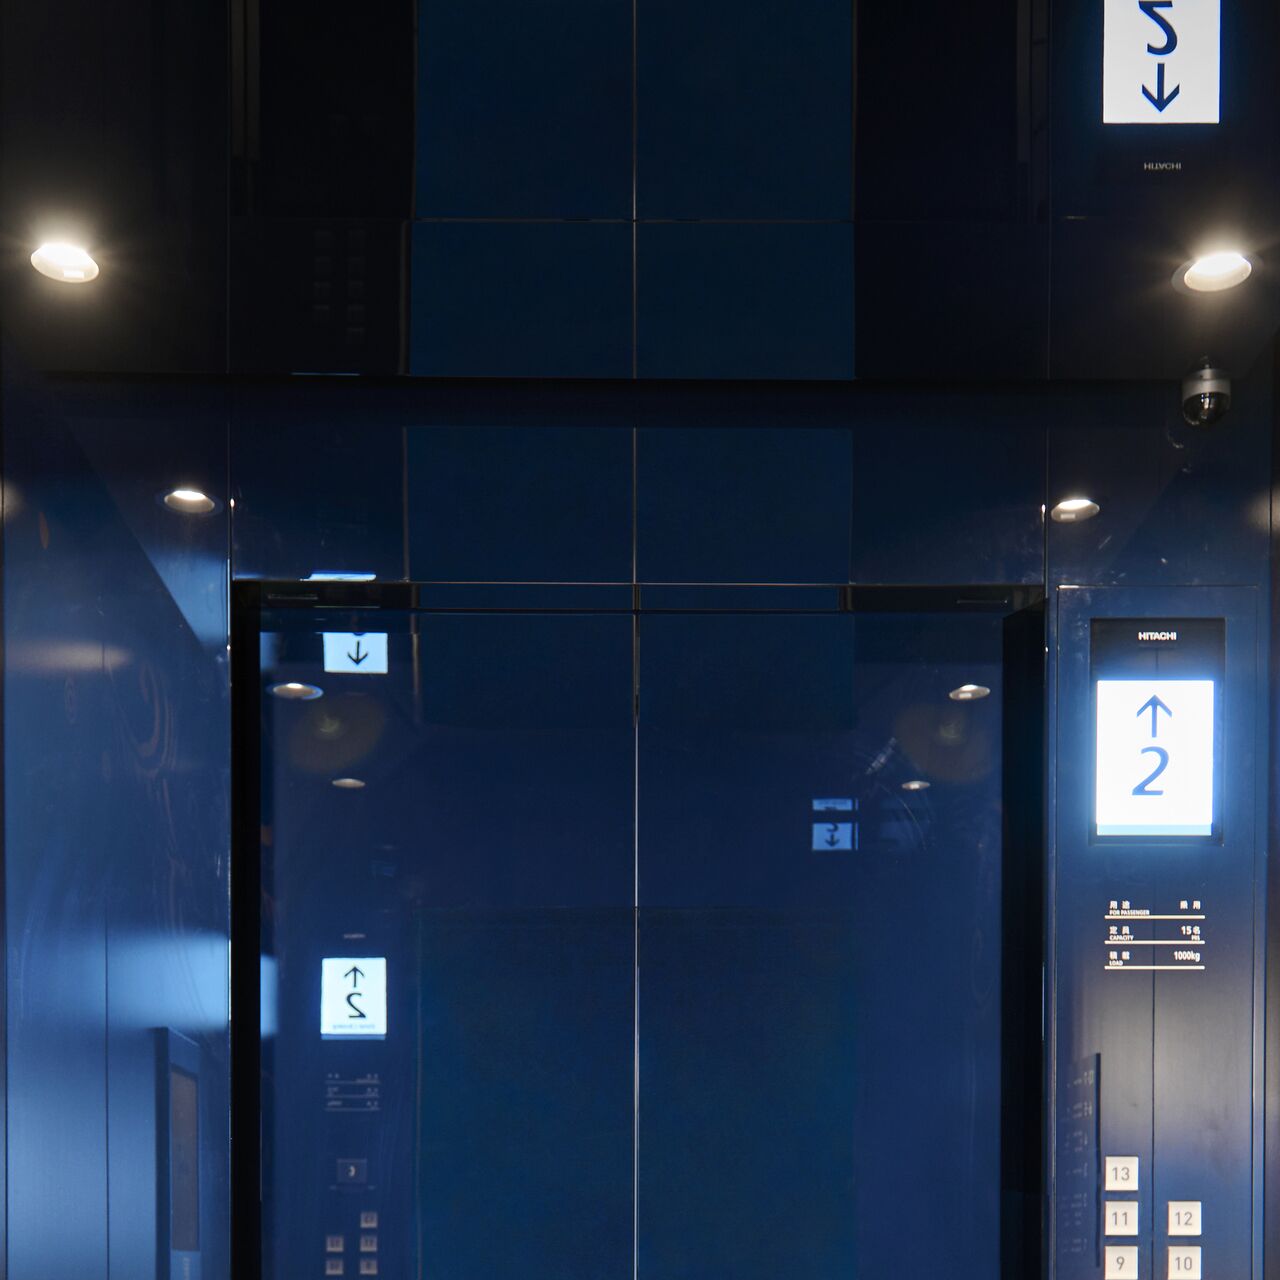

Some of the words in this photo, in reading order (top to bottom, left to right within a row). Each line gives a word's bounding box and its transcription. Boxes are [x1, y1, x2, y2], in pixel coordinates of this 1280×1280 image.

[1138, 632, 1177, 641] HITACHI
[1131, 746, 1170, 796] 2
[1174, 951, 1200, 962] 1000kg
[1112, 1167, 1130, 1181] 13
[1112, 1212, 1128, 1226] 11
[1175, 1212, 1193, 1226] 12
[1116, 1256, 1125, 1270] 9
[1175, 1256, 1193, 1270] 10
